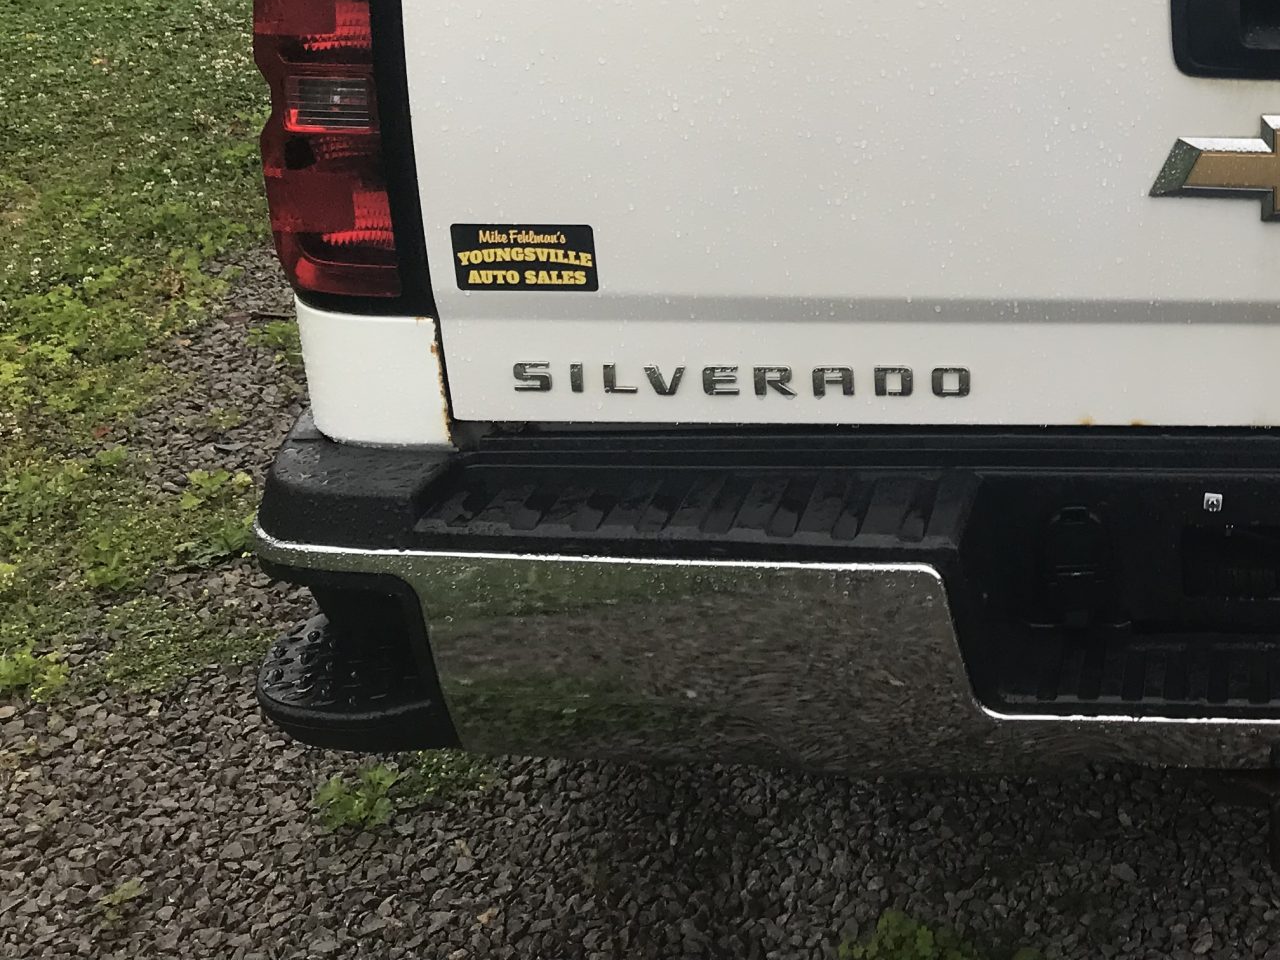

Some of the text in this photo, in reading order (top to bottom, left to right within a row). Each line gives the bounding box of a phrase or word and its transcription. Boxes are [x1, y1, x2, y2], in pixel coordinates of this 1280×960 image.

[478, 230, 508, 244] Mike
[457, 247, 593, 267] YOUNGSVILLE
[468, 270, 587, 285] AUTO SALES
[513, 361, 971, 398] SILVERADO
